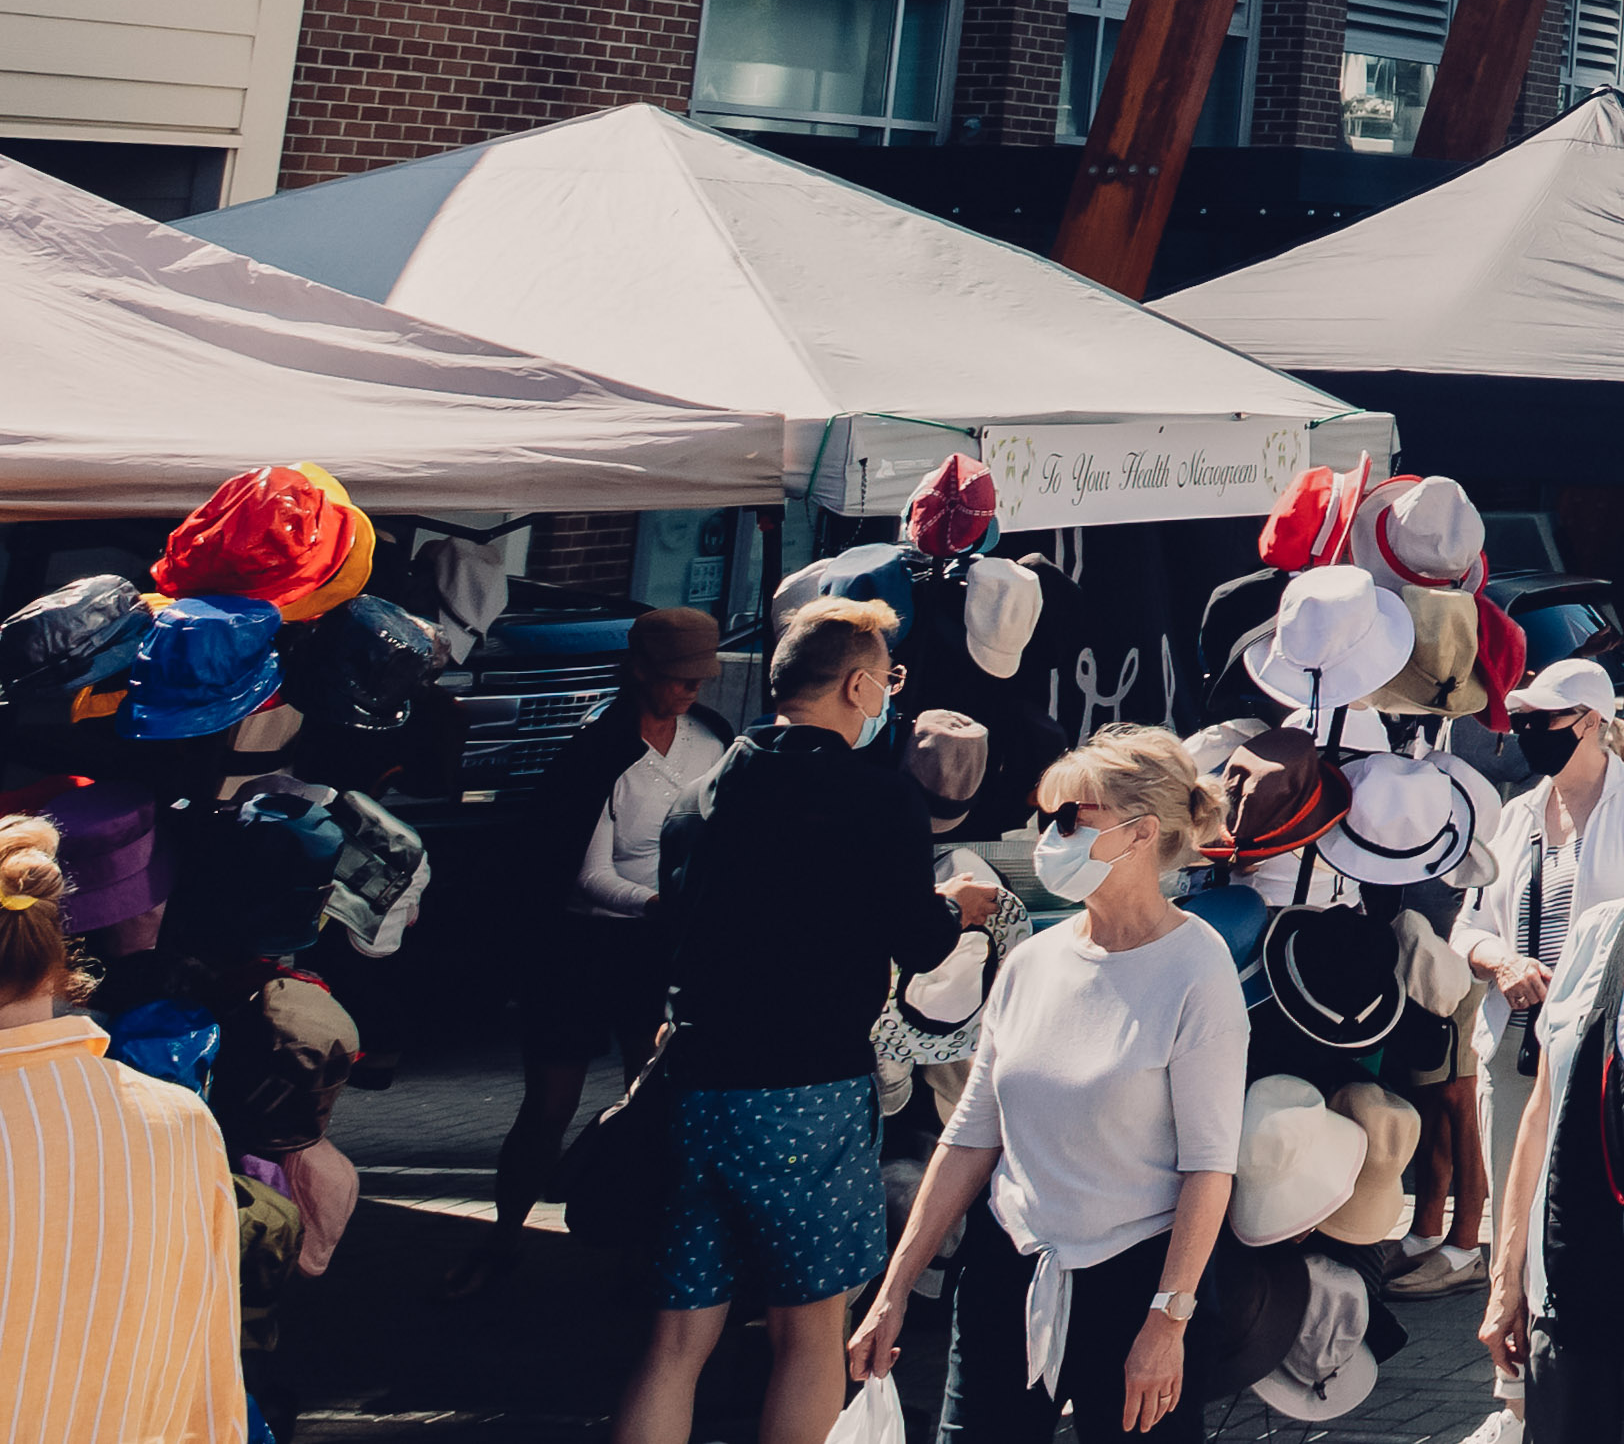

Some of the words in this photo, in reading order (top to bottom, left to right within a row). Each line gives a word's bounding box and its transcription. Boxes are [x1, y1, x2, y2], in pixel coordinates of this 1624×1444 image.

[1039, 453, 1064, 494] To
[1071, 452, 1111, 506] Your
[1119, 449, 1171, 491] Health
[1177, 449, 1258, 497] Microgreens
